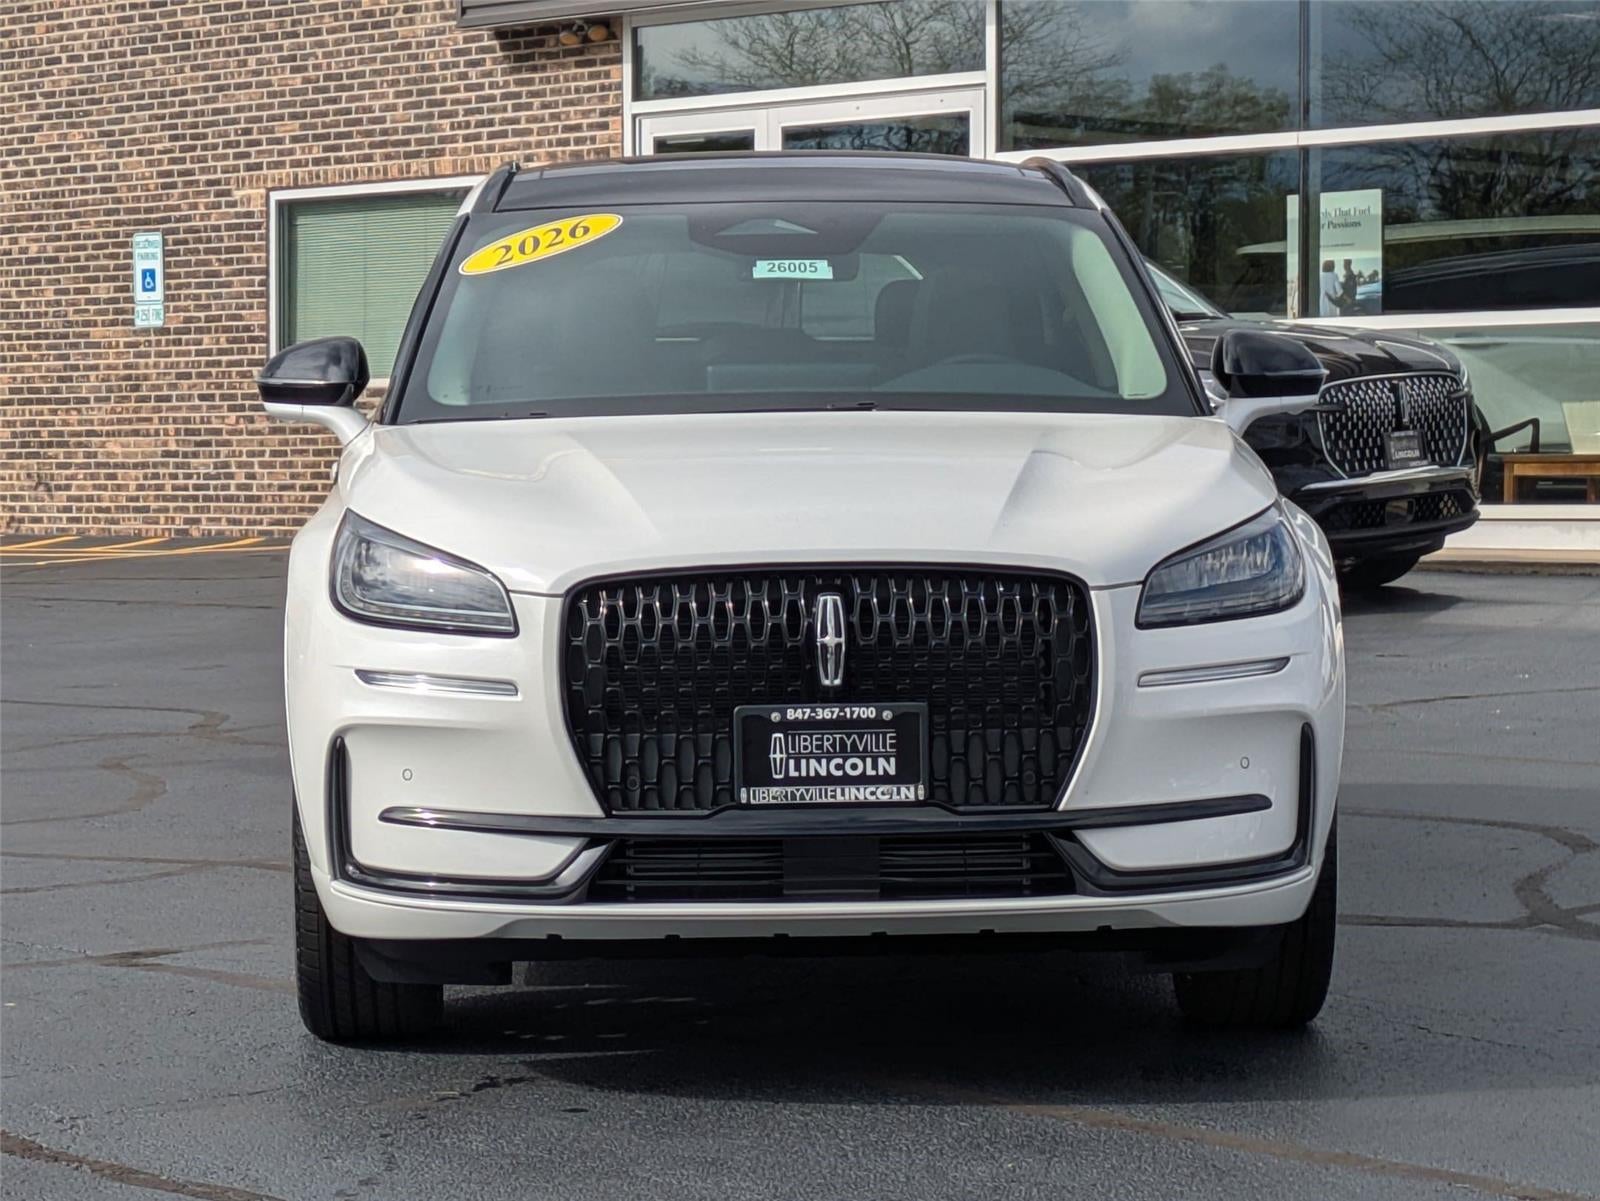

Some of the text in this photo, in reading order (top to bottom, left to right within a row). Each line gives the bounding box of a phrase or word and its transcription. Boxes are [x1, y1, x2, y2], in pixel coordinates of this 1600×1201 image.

[1334, 207, 1352, 217] That
[1354, 205, 1371, 217] Fuel
[1328, 219, 1362, 229] Passions
[493, 218, 591, 267] 2026
[767, 261, 818, 273] 26005
[786, 706, 877, 720] 847-367-1700
[788, 733, 897, 753] LIBERTYVILLE
[788, 756, 896, 777] LINCOLN
